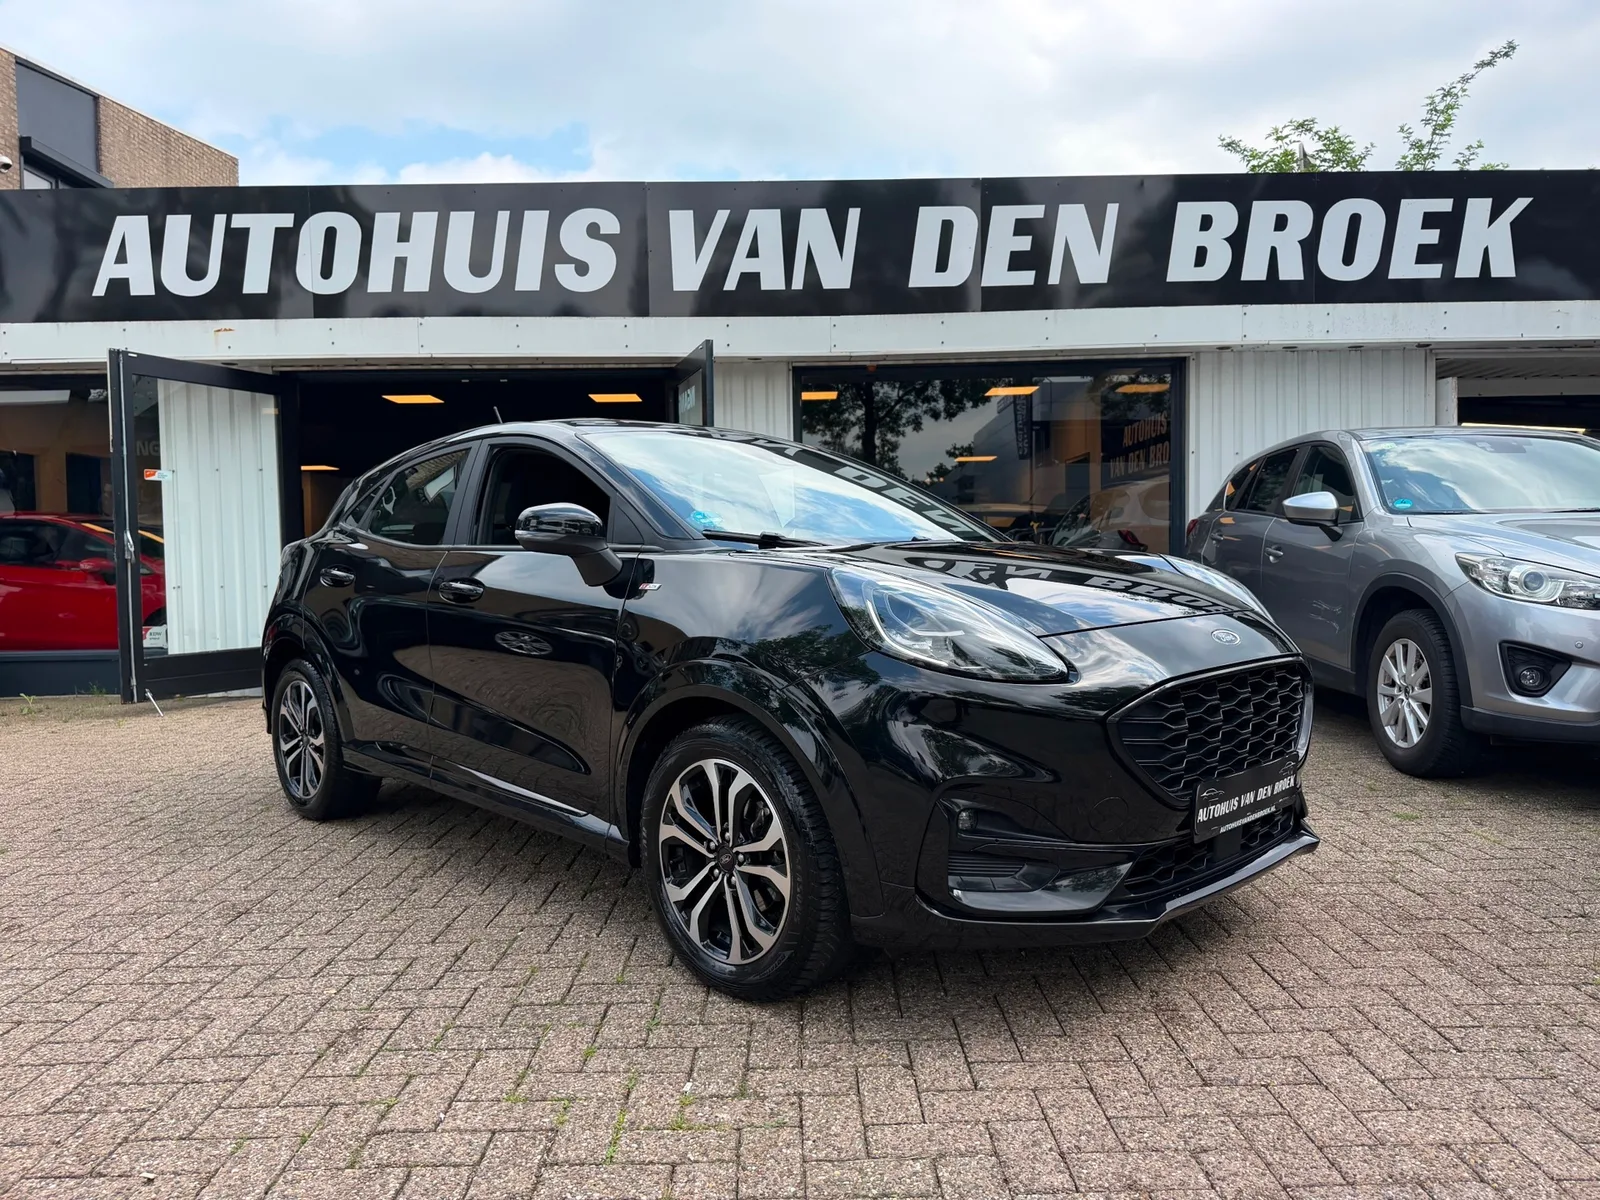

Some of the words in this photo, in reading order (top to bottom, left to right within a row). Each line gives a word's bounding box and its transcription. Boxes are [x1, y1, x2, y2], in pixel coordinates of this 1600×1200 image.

[92, 208, 621, 298] AUTOHUIS
[668, 207, 861, 292] VAN
[908, 203, 1120, 288] DEN
[1166, 197, 1533, 283] BROEK
[1123, 411, 1168, 448] AUTOHUIS
[1110, 455, 1126, 479] VAN
[1128, 448, 1146, 474] DEN
[1197, 796, 1239, 823] AUTOHUIS
[1240, 790, 1256, 807] VAN
[1256, 784, 1273, 801] DEN
[1273, 774, 1296, 795] BROEK
